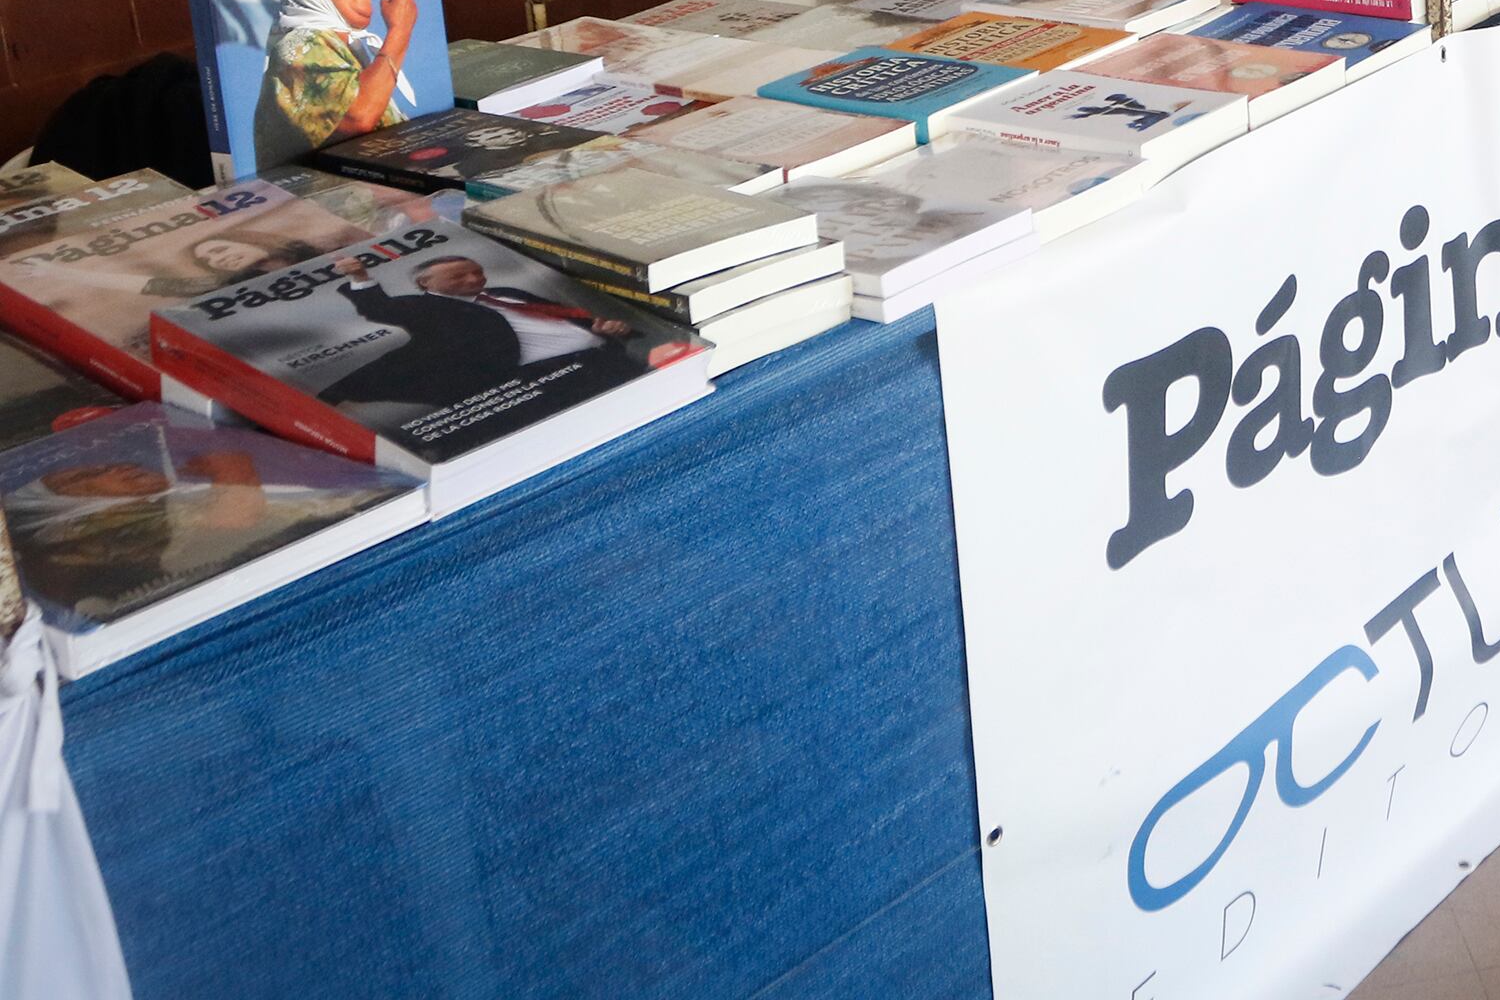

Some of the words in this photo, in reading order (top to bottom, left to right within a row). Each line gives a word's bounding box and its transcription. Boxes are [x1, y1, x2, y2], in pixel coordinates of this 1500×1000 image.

[923, 19, 1014, 56] HISTORIA
[810, 56, 910, 93] HISTORIA
[831, 59, 928, 96] CRÍTICA
[1010, 93, 1053, 114] Amor
[1063, 82, 1081, 95] la
[1025, 83, 1097, 116] argentina
[987, 155, 1101, 204] NOSOTROS
[287, 326, 392, 370] KIRCHNER
[401, 415, 422, 431] NO
[422, 405, 452, 422] VINE
[500, 377, 522, 392] MIS
[411, 396, 503, 437] CONVICCIONES
[499, 387, 523, 403] EN
[538, 361, 584, 387] PUERTA
[421, 429, 440, 442] DE
[459, 407, 493, 427] CASA
[491, 389, 543, 414] ROSADA
